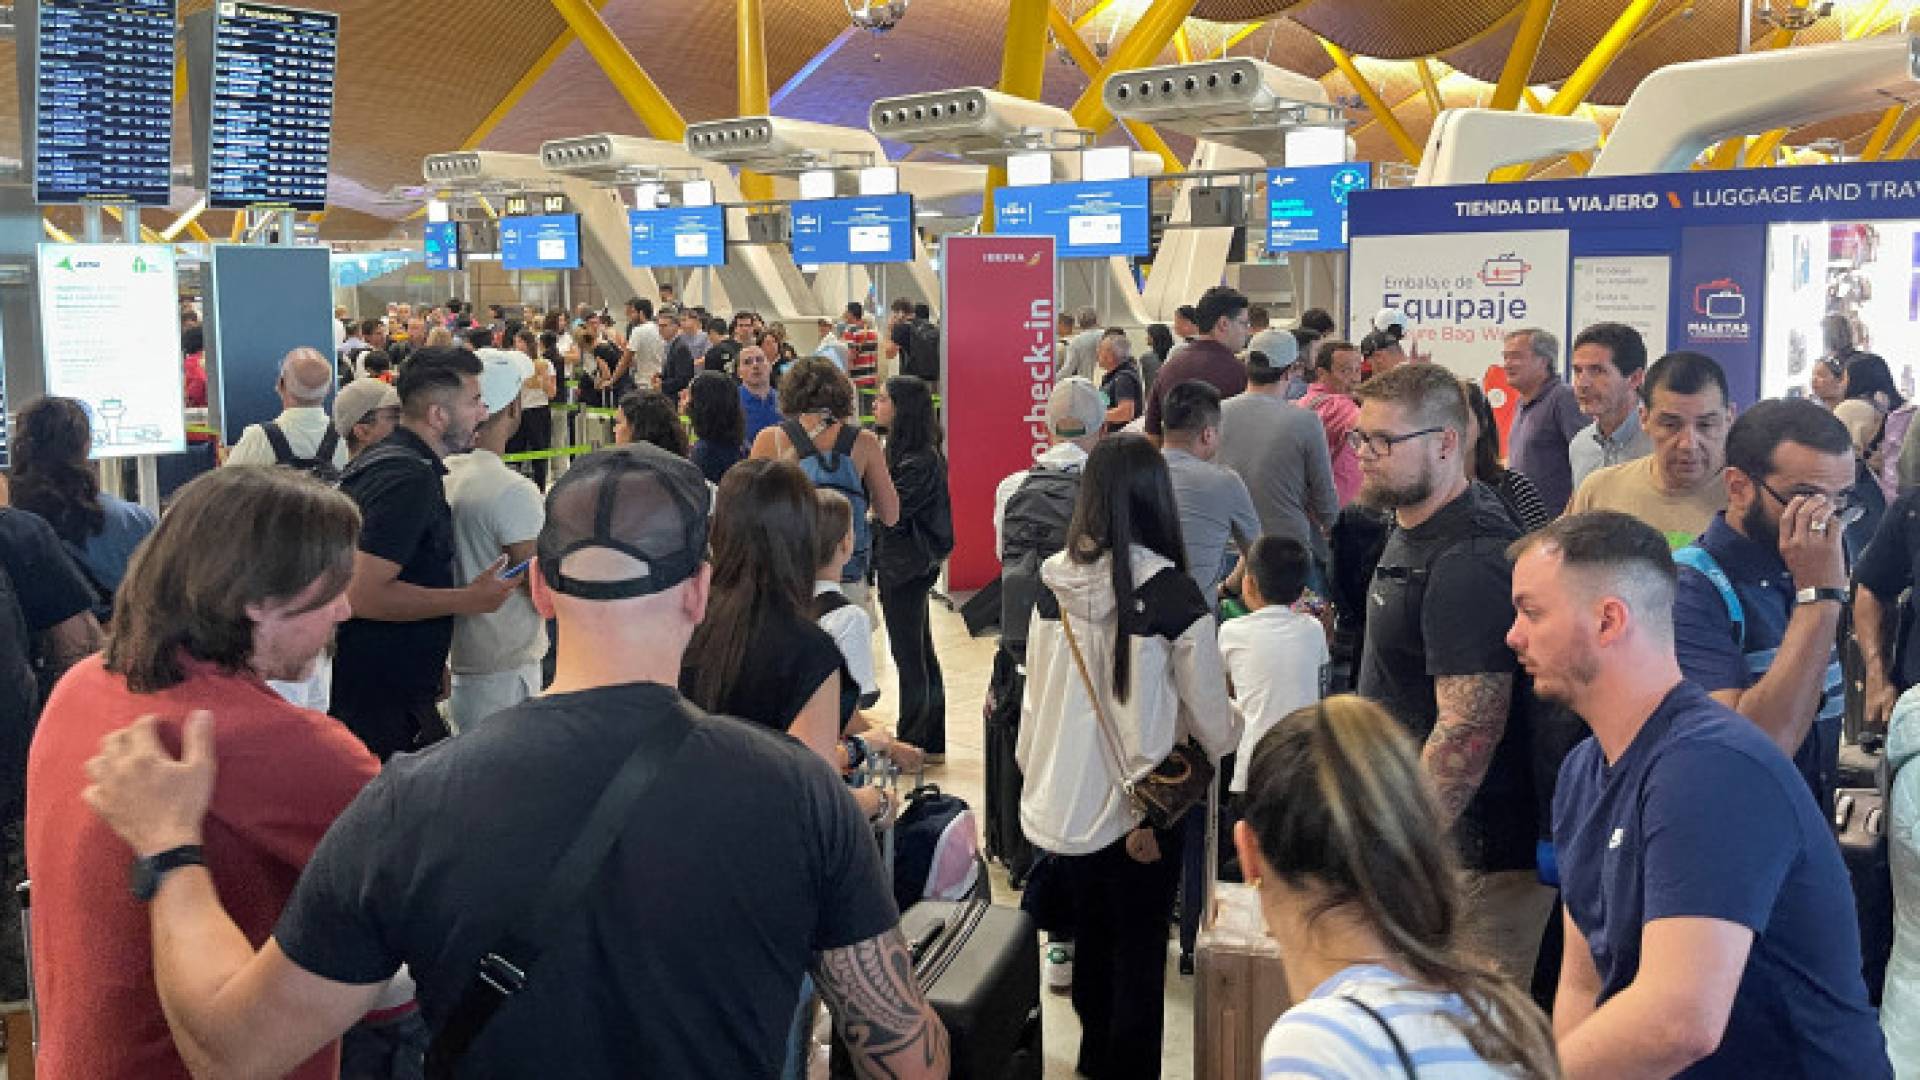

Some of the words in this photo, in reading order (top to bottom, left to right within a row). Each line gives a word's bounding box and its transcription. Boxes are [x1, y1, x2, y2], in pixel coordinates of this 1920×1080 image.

[1455, 199, 1523, 217] TIENDA
[1527, 197, 1564, 214] DEL
[1568, 193, 1659, 212] VIAJERO
[1693, 186, 1803, 207] LUGGAGE
[1808, 183, 1861, 201] AND
[1384, 275, 1451, 292] Embalaje
[1455, 275, 1473, 290] de
[1383, 291, 1527, 324] Equipaje
[1441, 326, 1475, 343] Bag
[1023, 299, 1052, 466] ocheck-in
